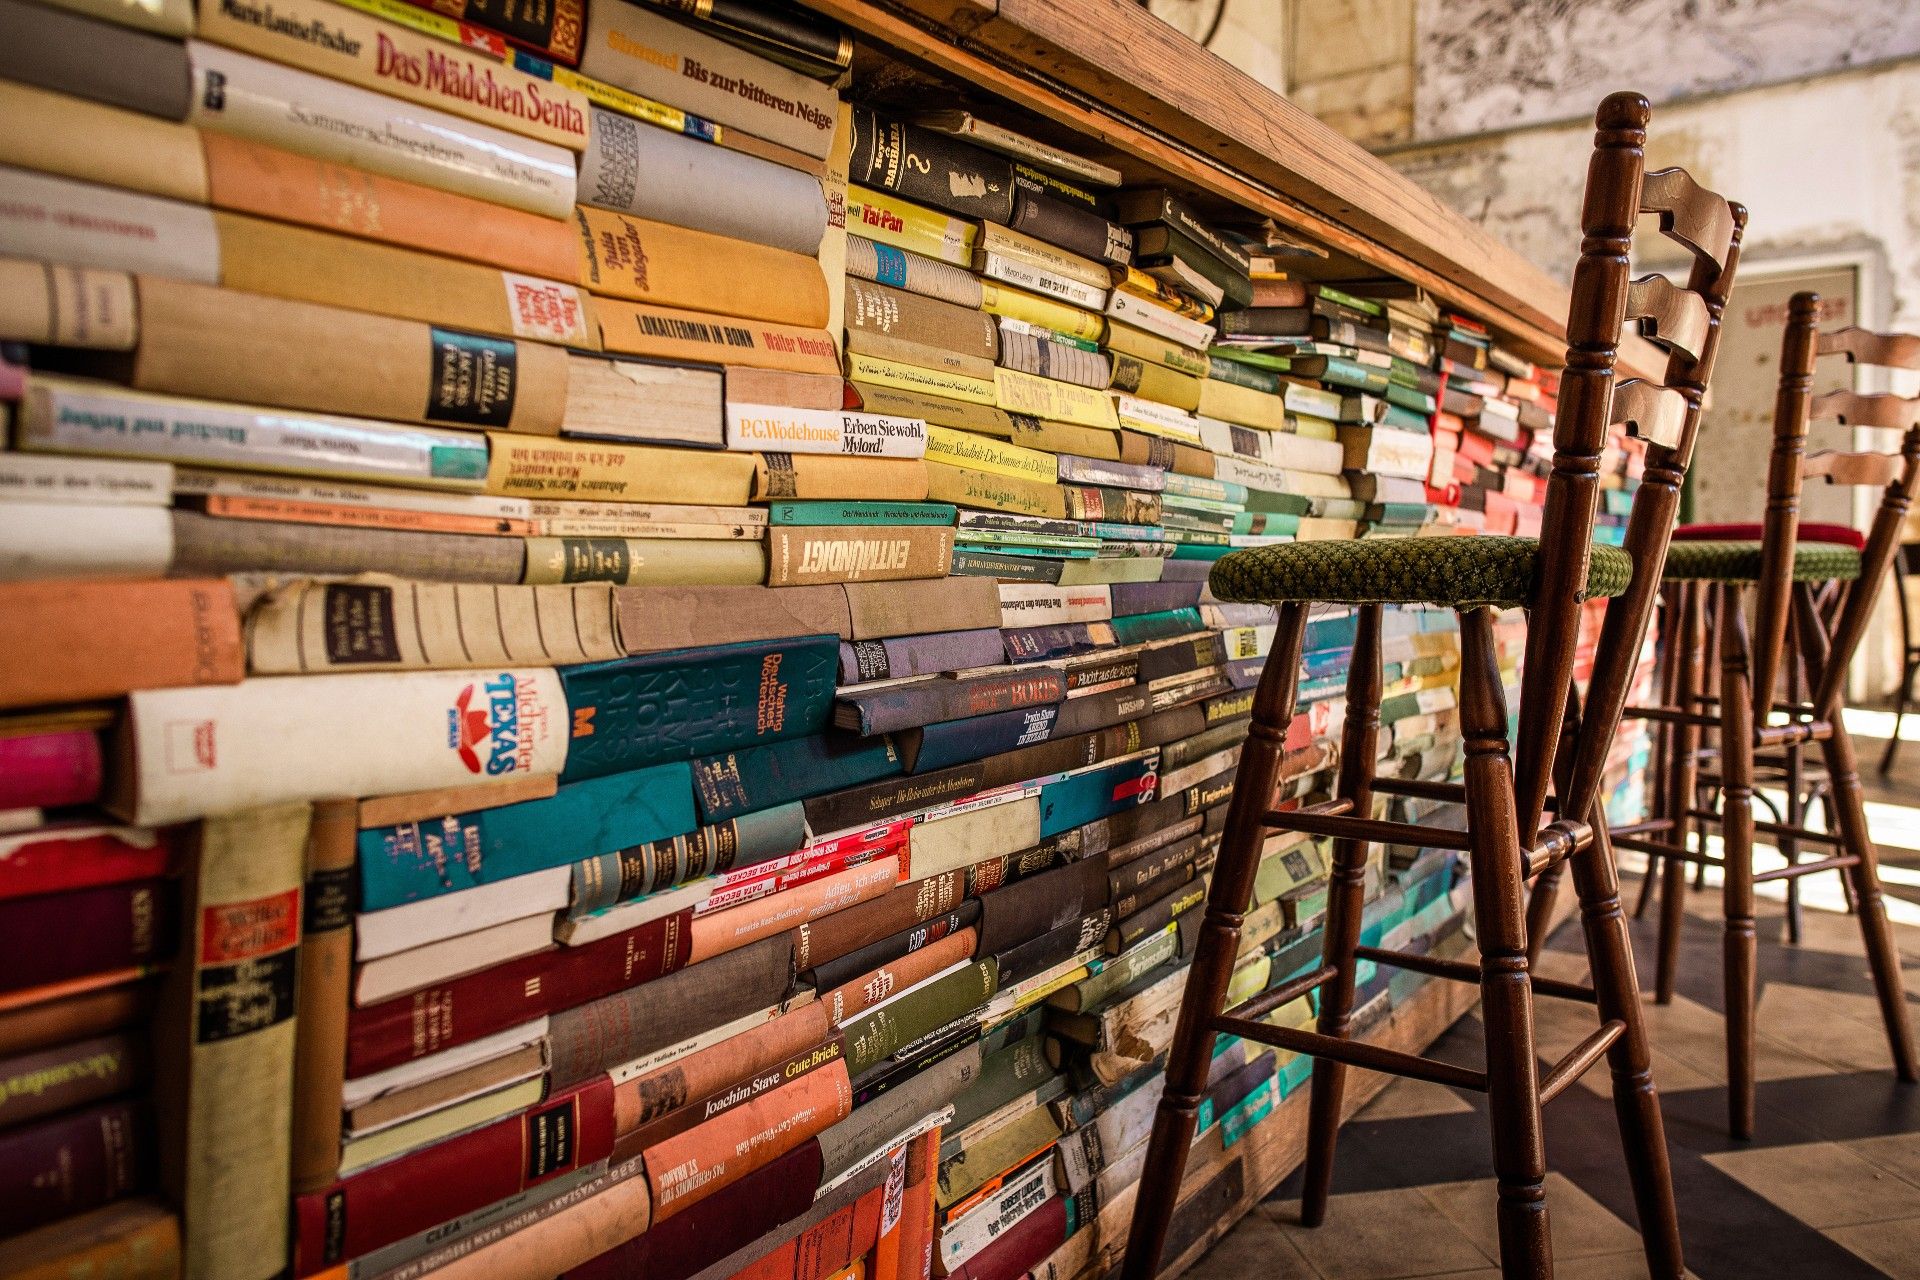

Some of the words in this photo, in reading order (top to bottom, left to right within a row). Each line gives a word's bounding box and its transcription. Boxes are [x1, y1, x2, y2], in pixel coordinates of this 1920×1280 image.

[376, 31, 421, 87] Das
[425, 50, 526, 119] Mädchen
[527, 81, 585, 136] Senta
[682, 56, 709, 85] Bis
[711, 67, 739, 93] zur
[738, 78, 797, 119] bitteren
[795, 102, 833, 131] Neige
[873, 128, 886, 170] Heyer
[884, 121, 901, 190] BARBARA
[862, 203, 903, 234] Tai-Pan
[635, 313, 710, 344] LOKALTERMIN
[709, 325, 723, 345] IN
[723, 326, 755, 349] BONN
[762, 331, 797, 354] Walter
[764, 418, 840, 442] Wodehouse
[841, 435, 884, 455] Mylord!
[842, 416, 879, 436] Erben
[878, 418, 895, 438] Sie
[893, 419, 924, 442] wohl,
[926, 432, 954, 455] Maurice
[780, 533, 790, 583] KONSALIK
[798, 539, 911, 580] ENTMÜNDIGT
[936, 532, 948, 573] LINGEN
[756, 654, 774, 736] Wörterbuch
[765, 652, 784, 732] Deutsches
[773, 683, 789, 734] Wahrig
[1117, 698, 1146, 717] AIRSHIP
[484, 672, 518, 777] TEXAS
[516, 677, 537, 773] Michener
[725, 867, 758, 884] BECKER
[756, 861, 779, 877] DATA
[825, 878, 853, 899] Adieu,
[854, 874, 869, 889] ich
[868, 867, 892, 886] rette
[707, 888, 741, 907] BECKER
[740, 882, 764, 898] DATA
[806, 897, 838, 918] meine
[798, 922, 811, 969] Lingen
[785, 1057, 811, 1079] Gute
[811, 1043, 840, 1067] Briefe
[703, 1086, 751, 1120] Joachim
[751, 1071, 781, 1095] Stave
